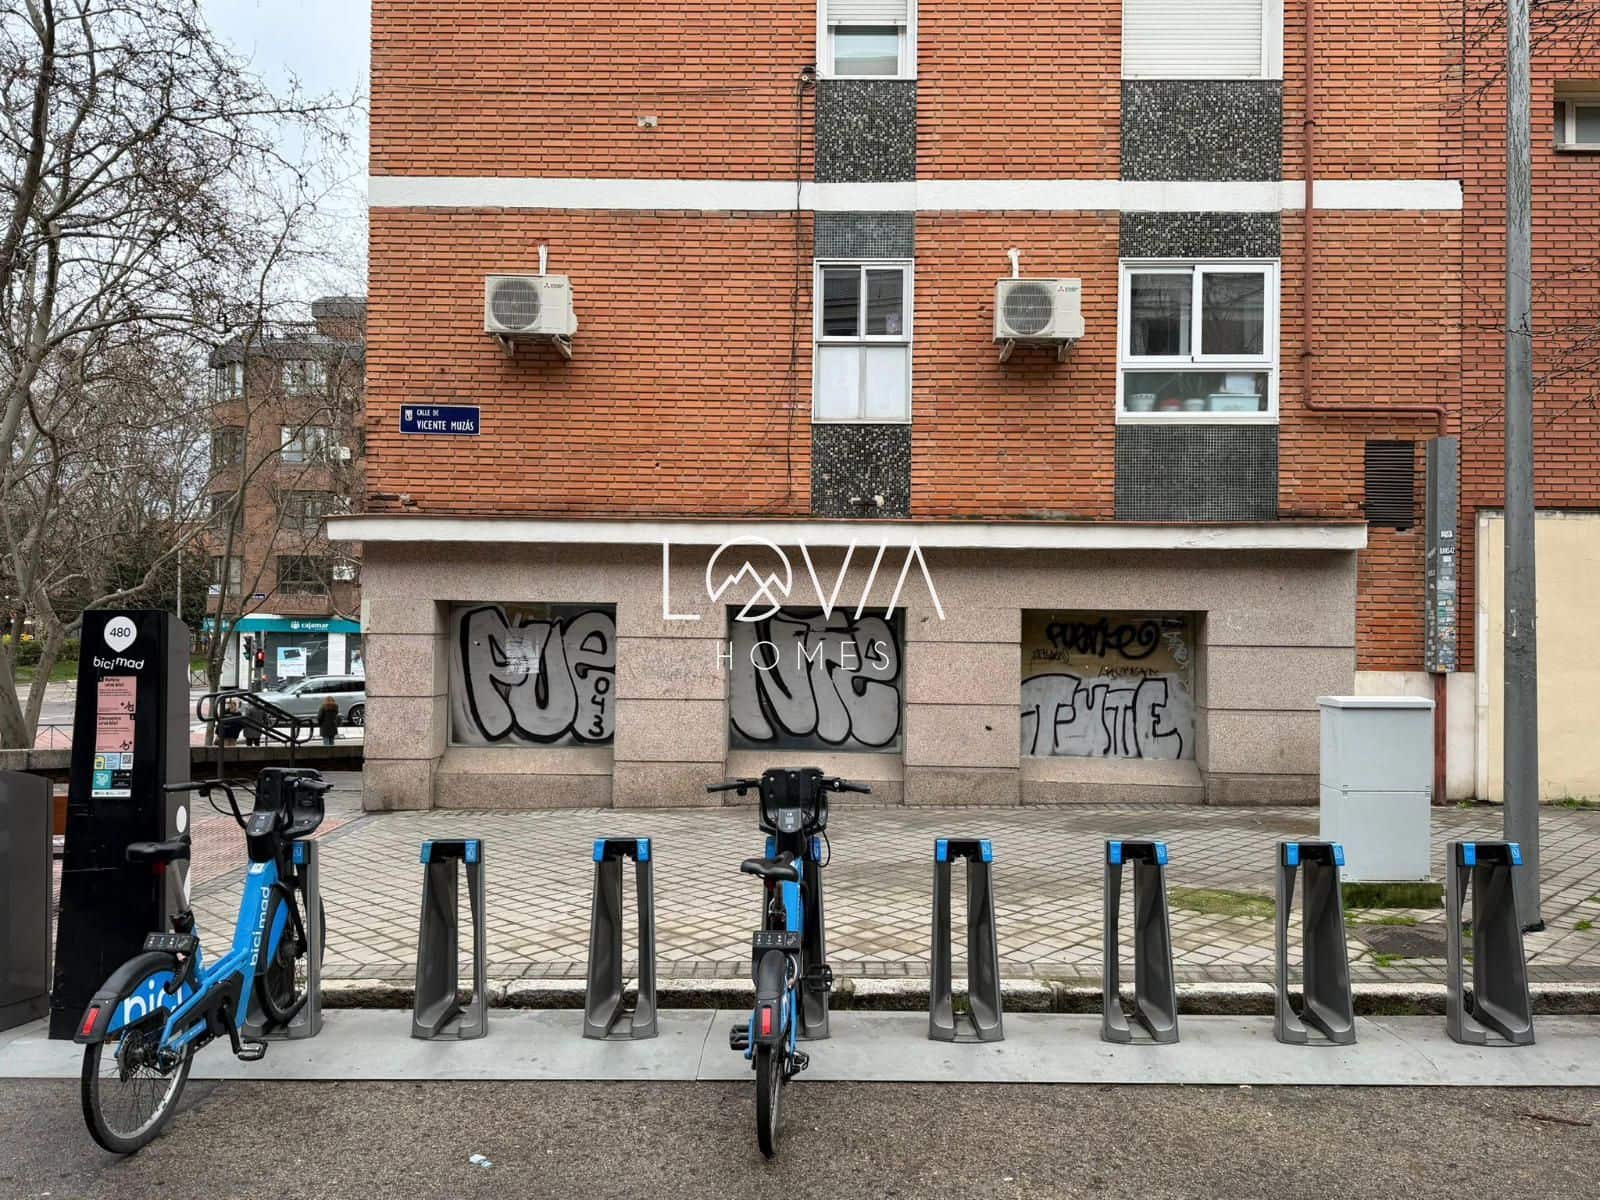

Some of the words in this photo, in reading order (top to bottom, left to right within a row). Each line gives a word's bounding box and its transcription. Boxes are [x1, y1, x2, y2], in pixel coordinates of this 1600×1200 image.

[416, 409, 430, 417] CALLE
[416, 420, 447, 431] VICENTE
[450, 419, 474, 431] MUZÁS
[109, 627, 131, 638] 480
